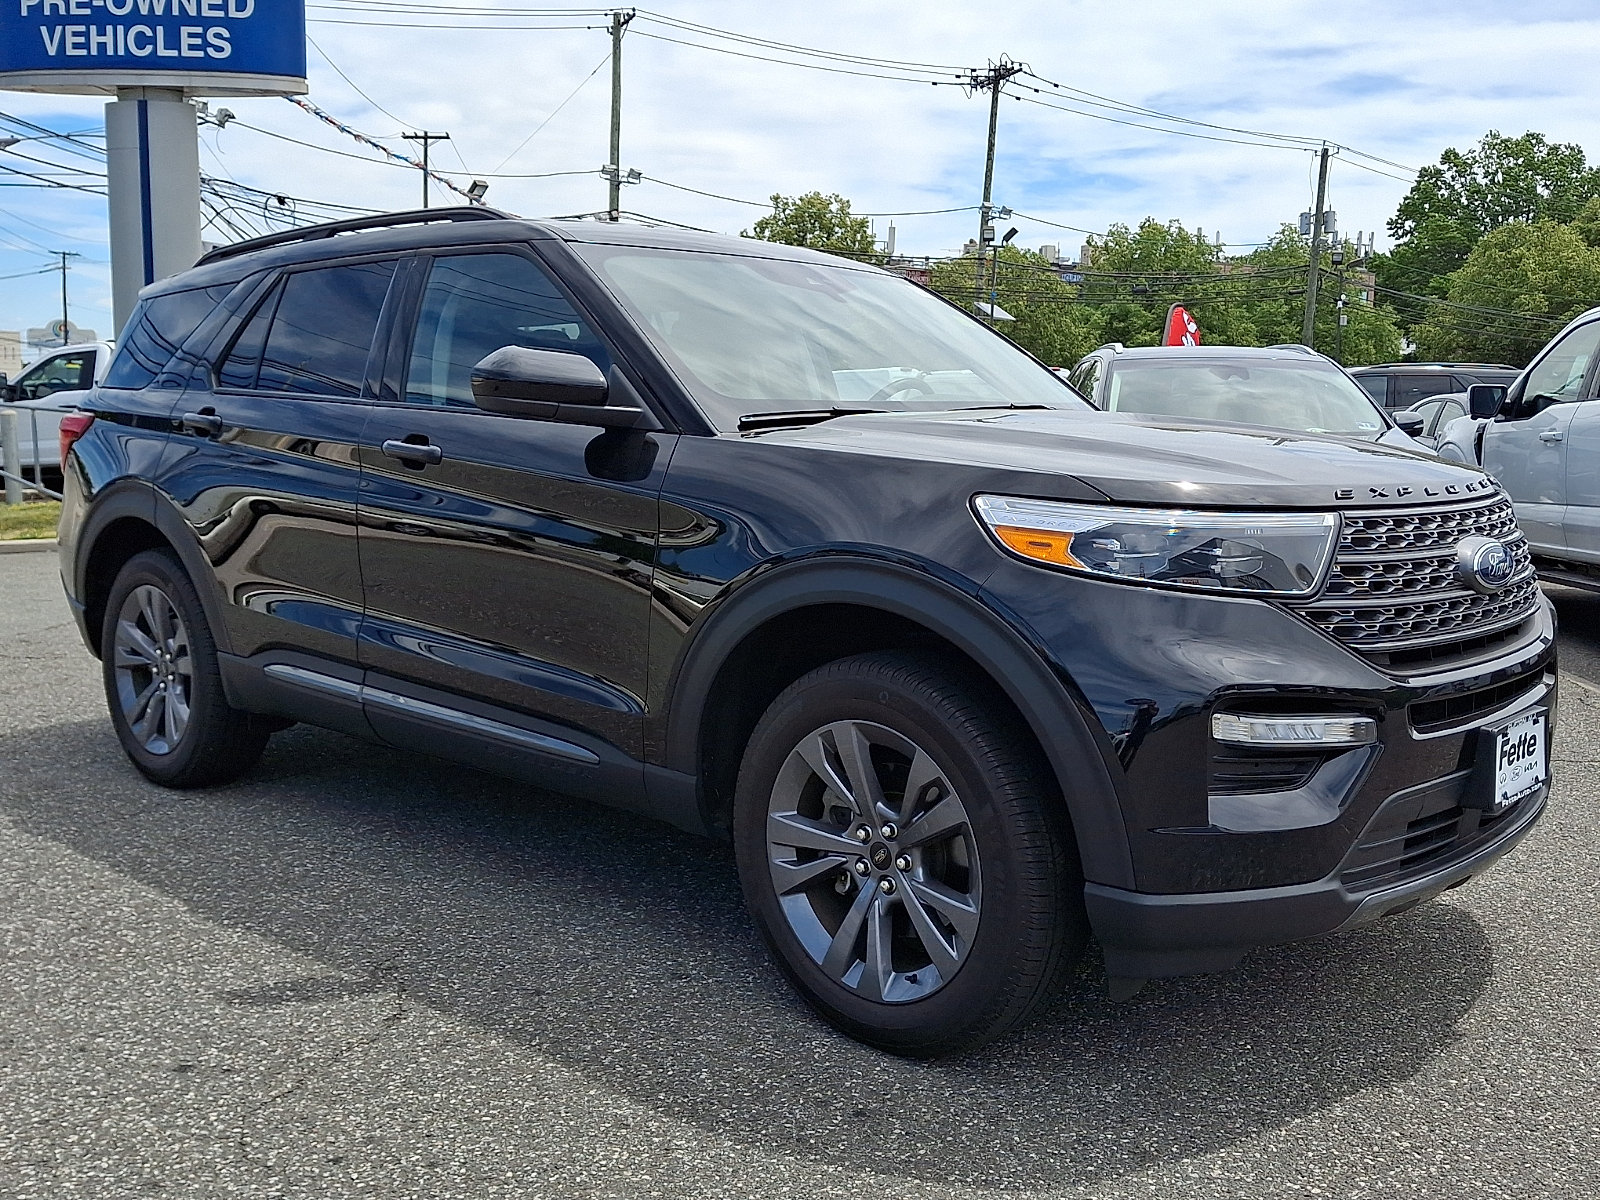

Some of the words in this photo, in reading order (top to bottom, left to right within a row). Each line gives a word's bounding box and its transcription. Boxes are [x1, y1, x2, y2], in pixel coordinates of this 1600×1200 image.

[20, 0, 255, 19] PRE-OWNED
[40, 25, 232, 59] VEHICLES
[1488, 552, 1511, 577] Ford
[1498, 732, 1538, 772] Fette
